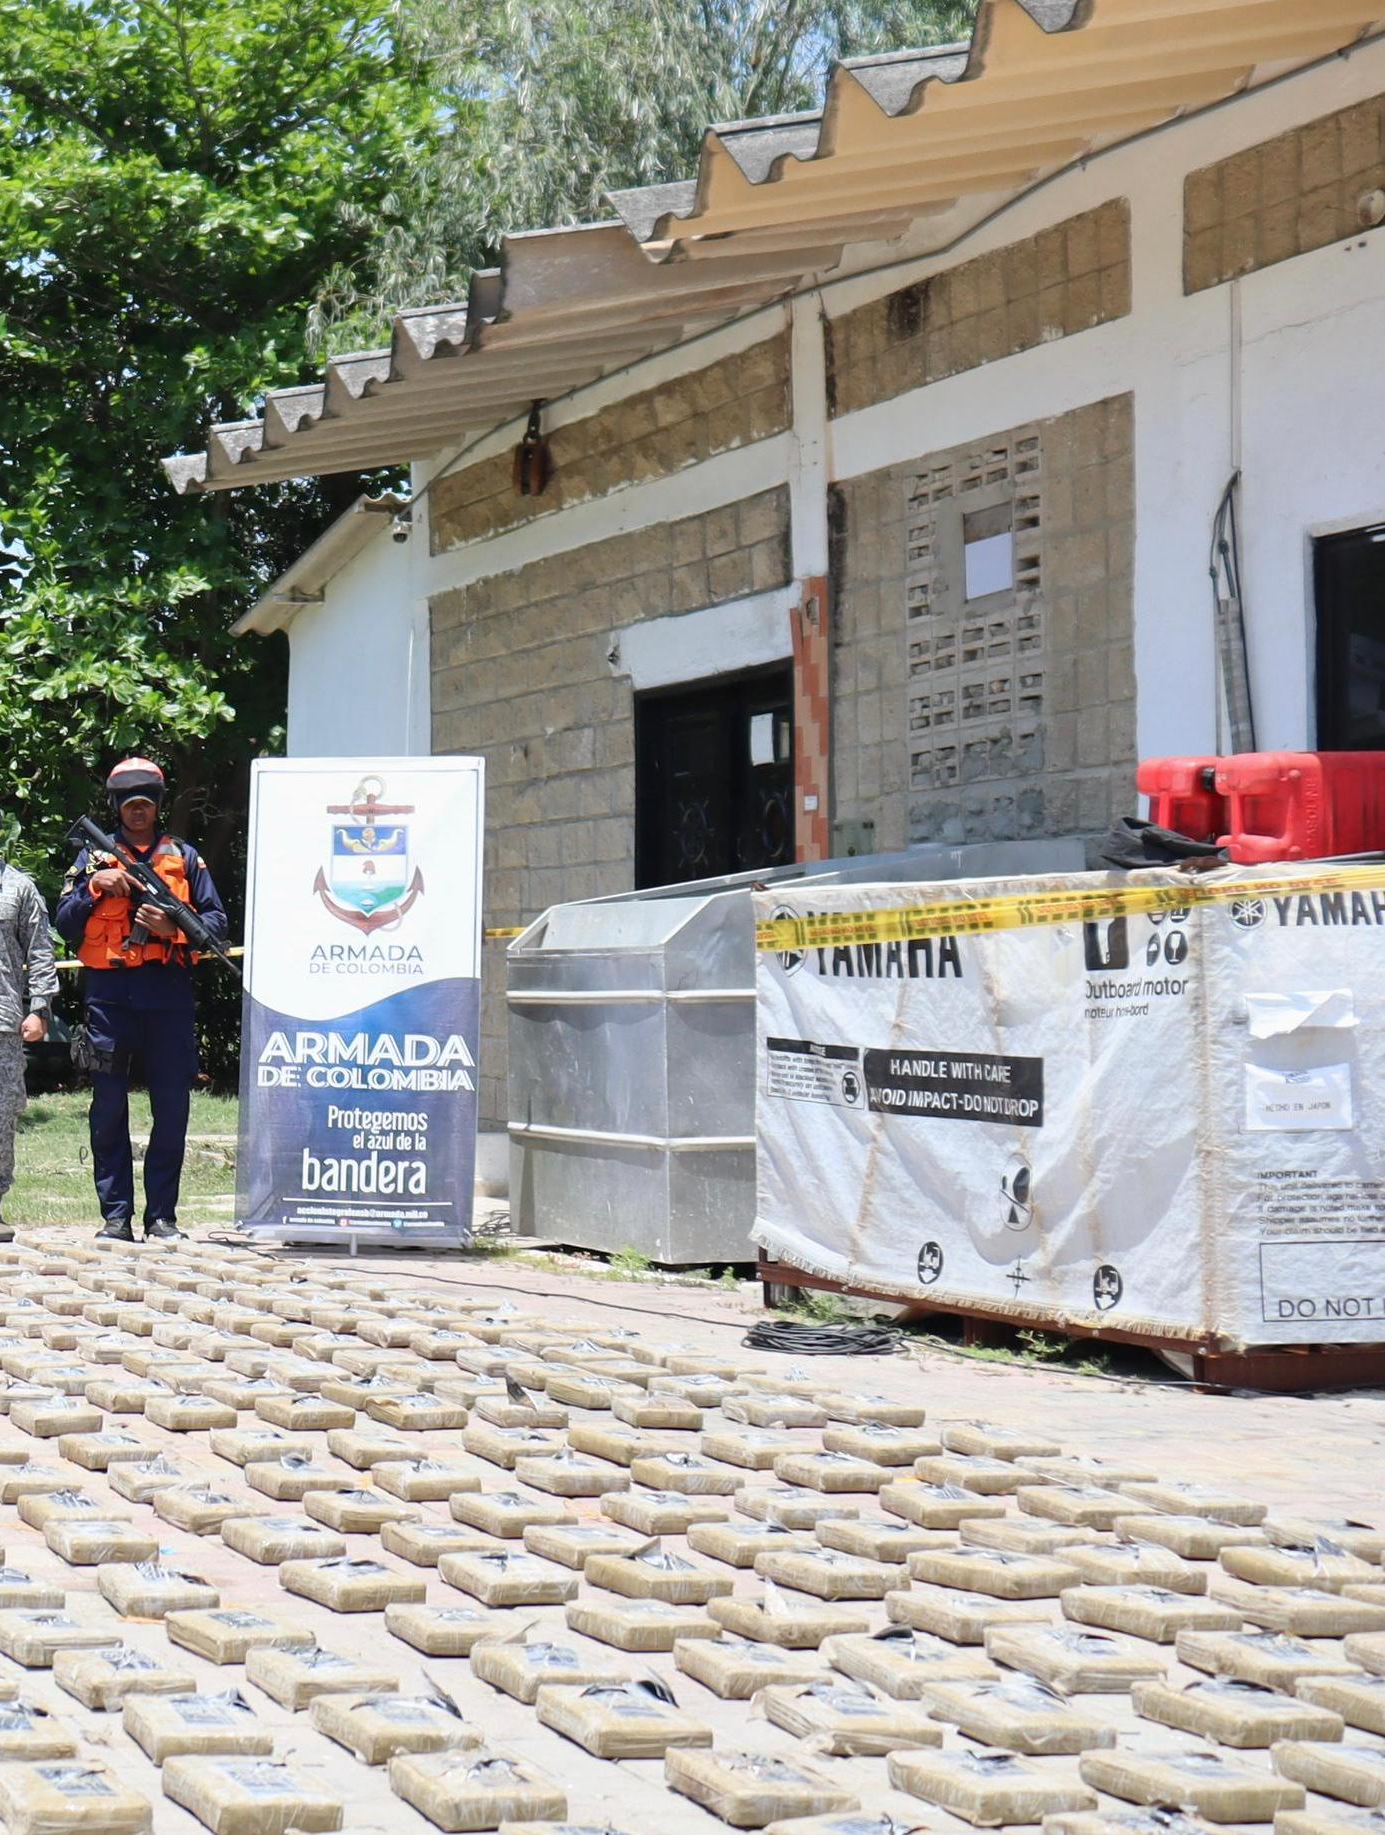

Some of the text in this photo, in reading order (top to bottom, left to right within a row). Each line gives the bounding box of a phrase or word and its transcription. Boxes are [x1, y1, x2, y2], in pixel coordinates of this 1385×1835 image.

[311, 944, 423, 962] ARMADA
[310, 963, 424, 975] DE COLOMBIA
[1143, 977, 1189, 996] motor
[258, 1031, 476, 1067] ARMADA
[257, 1065, 475, 1092] DE COLOMBIA
[890, 1059, 1012, 1083] HANDLE WITH CARE
[870, 1087, 906, 1107] AVOID
[984, 1096, 1003, 1115] NOT
[1004, 1098, 1039, 1118] DROP
[327, 1105, 428, 1134] Protegemos
[353, 1131, 427, 1151] el azul de la
[301, 1147, 427, 1195] bandera
[1258, 1170, 1318, 1180] IMPORTANT
[1279, 1298, 1374, 1318] DO NOT
